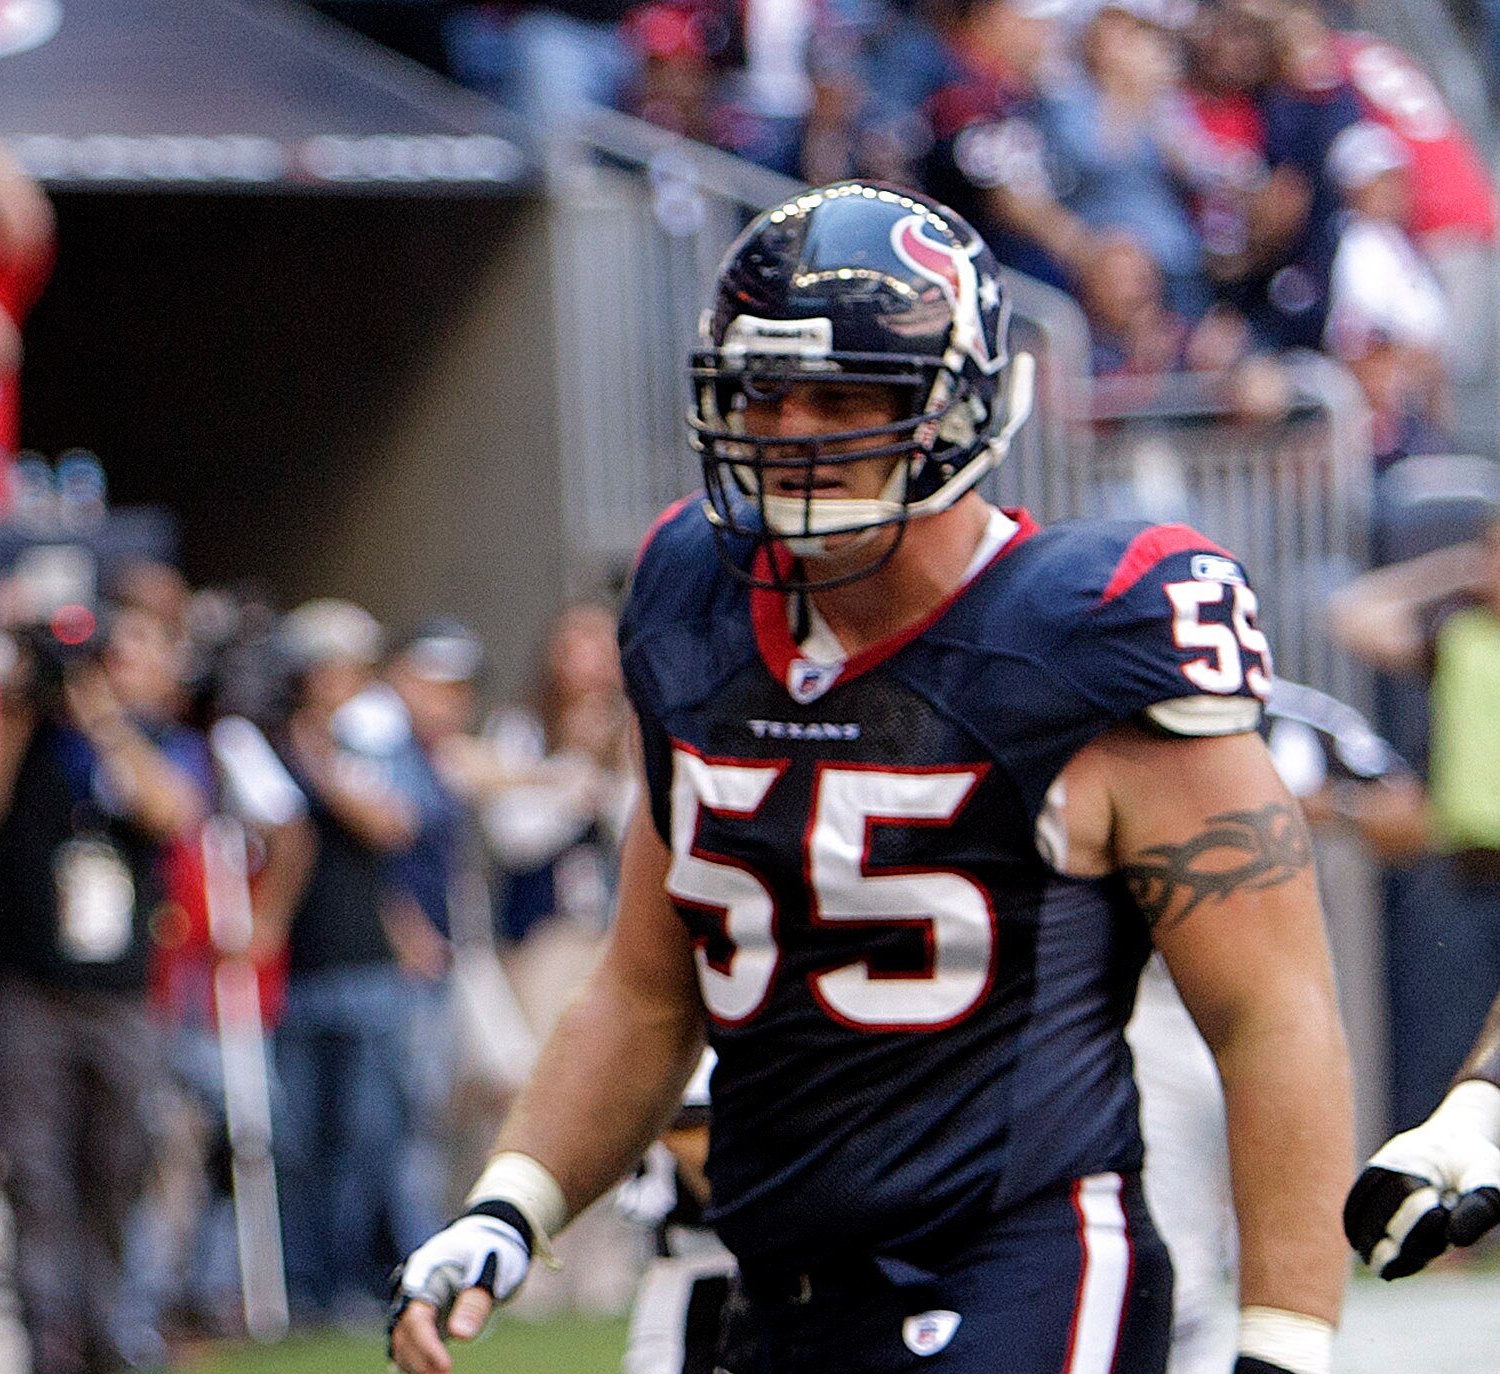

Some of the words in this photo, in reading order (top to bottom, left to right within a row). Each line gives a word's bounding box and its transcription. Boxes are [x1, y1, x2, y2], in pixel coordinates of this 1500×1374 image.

[1161, 579, 1274, 703] 55
[747, 719, 862, 741] TEXANS
[664, 738, 997, 1032] 55
